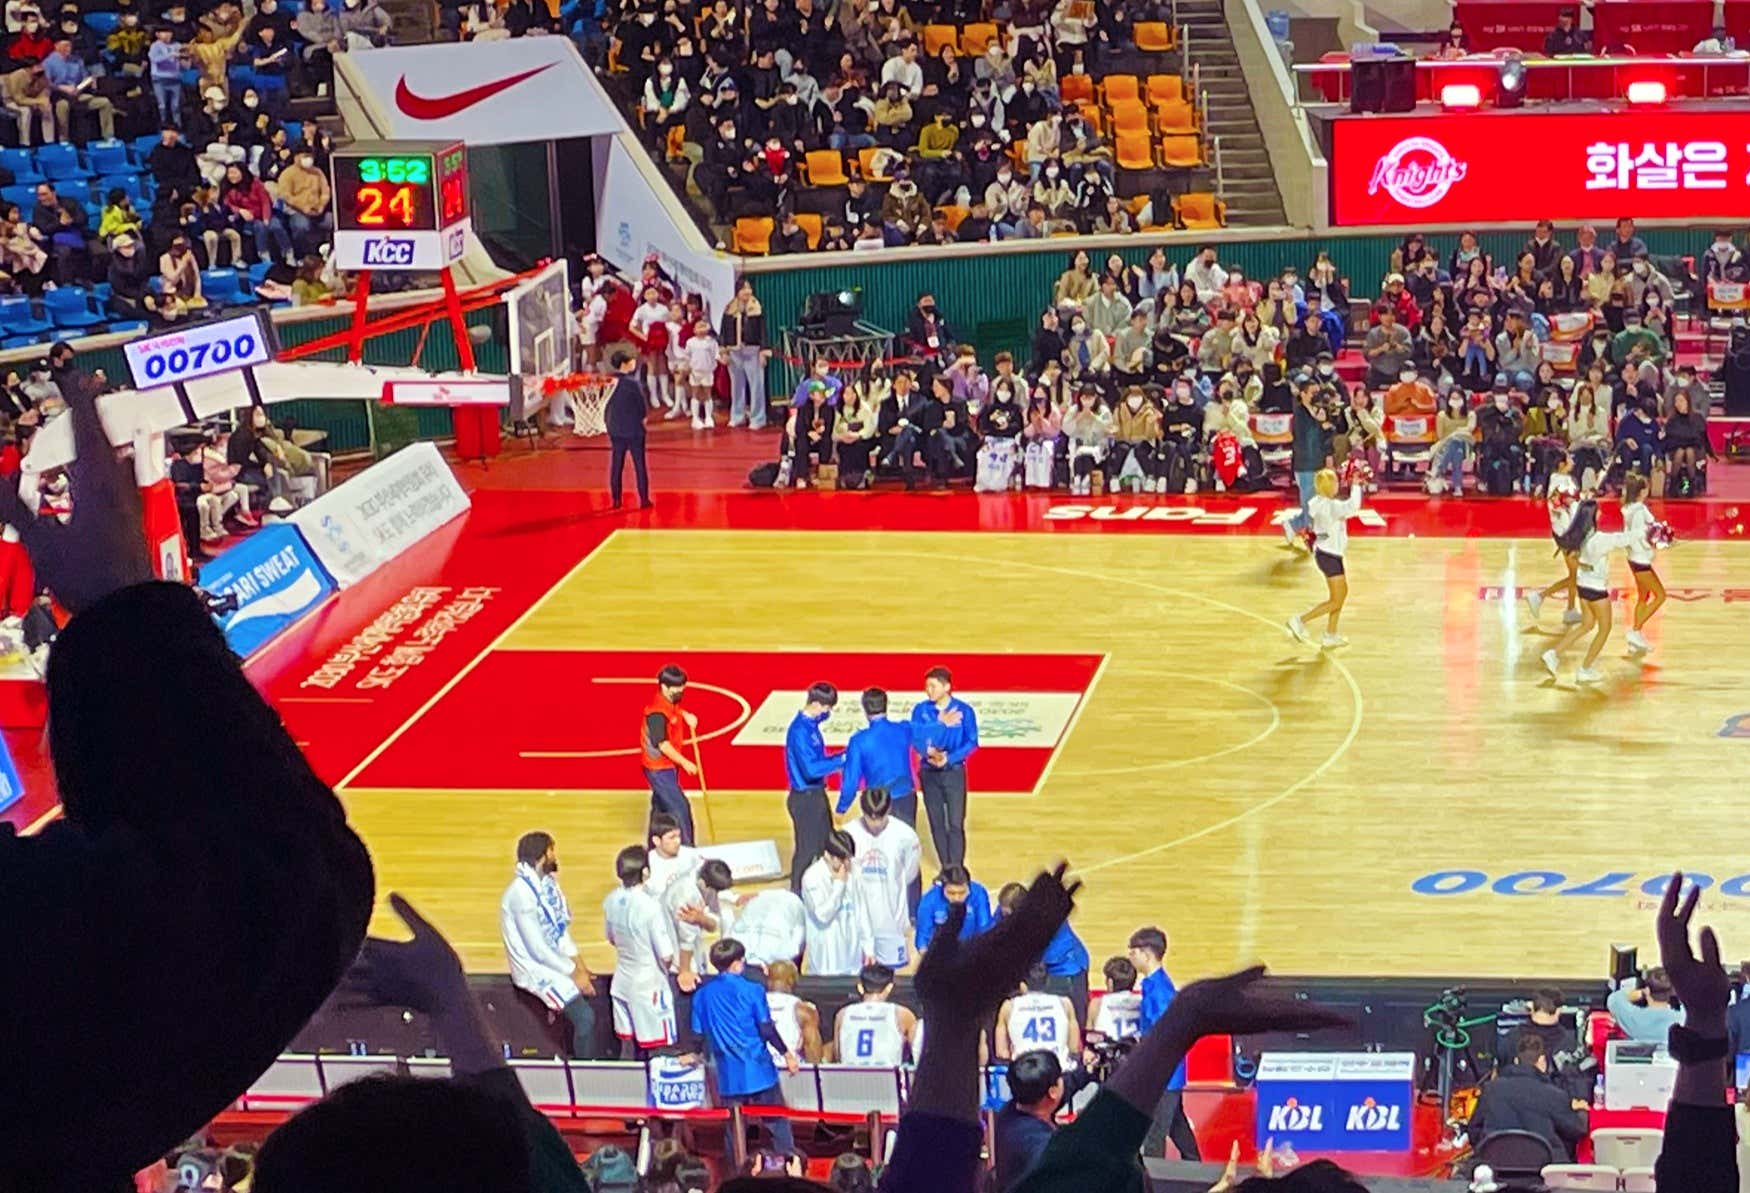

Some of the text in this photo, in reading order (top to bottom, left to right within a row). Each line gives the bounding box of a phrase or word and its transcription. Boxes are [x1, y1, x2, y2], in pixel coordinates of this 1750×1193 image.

[358, 158, 428, 184] 3:52
[1367, 155, 1467, 195] Knights
[1586, 141, 1728, 191] 화살은
[357, 187, 414, 225] 24
[366, 239, 413, 263] KCC
[145, 333, 256, 379] 00700
[1043, 504, 1257, 525] Fans
[252, 545, 301, 589] SWEAT
[1022, 1016, 1057, 1043] 43
[1269, 1104, 1400, 1131] KBL KBL
